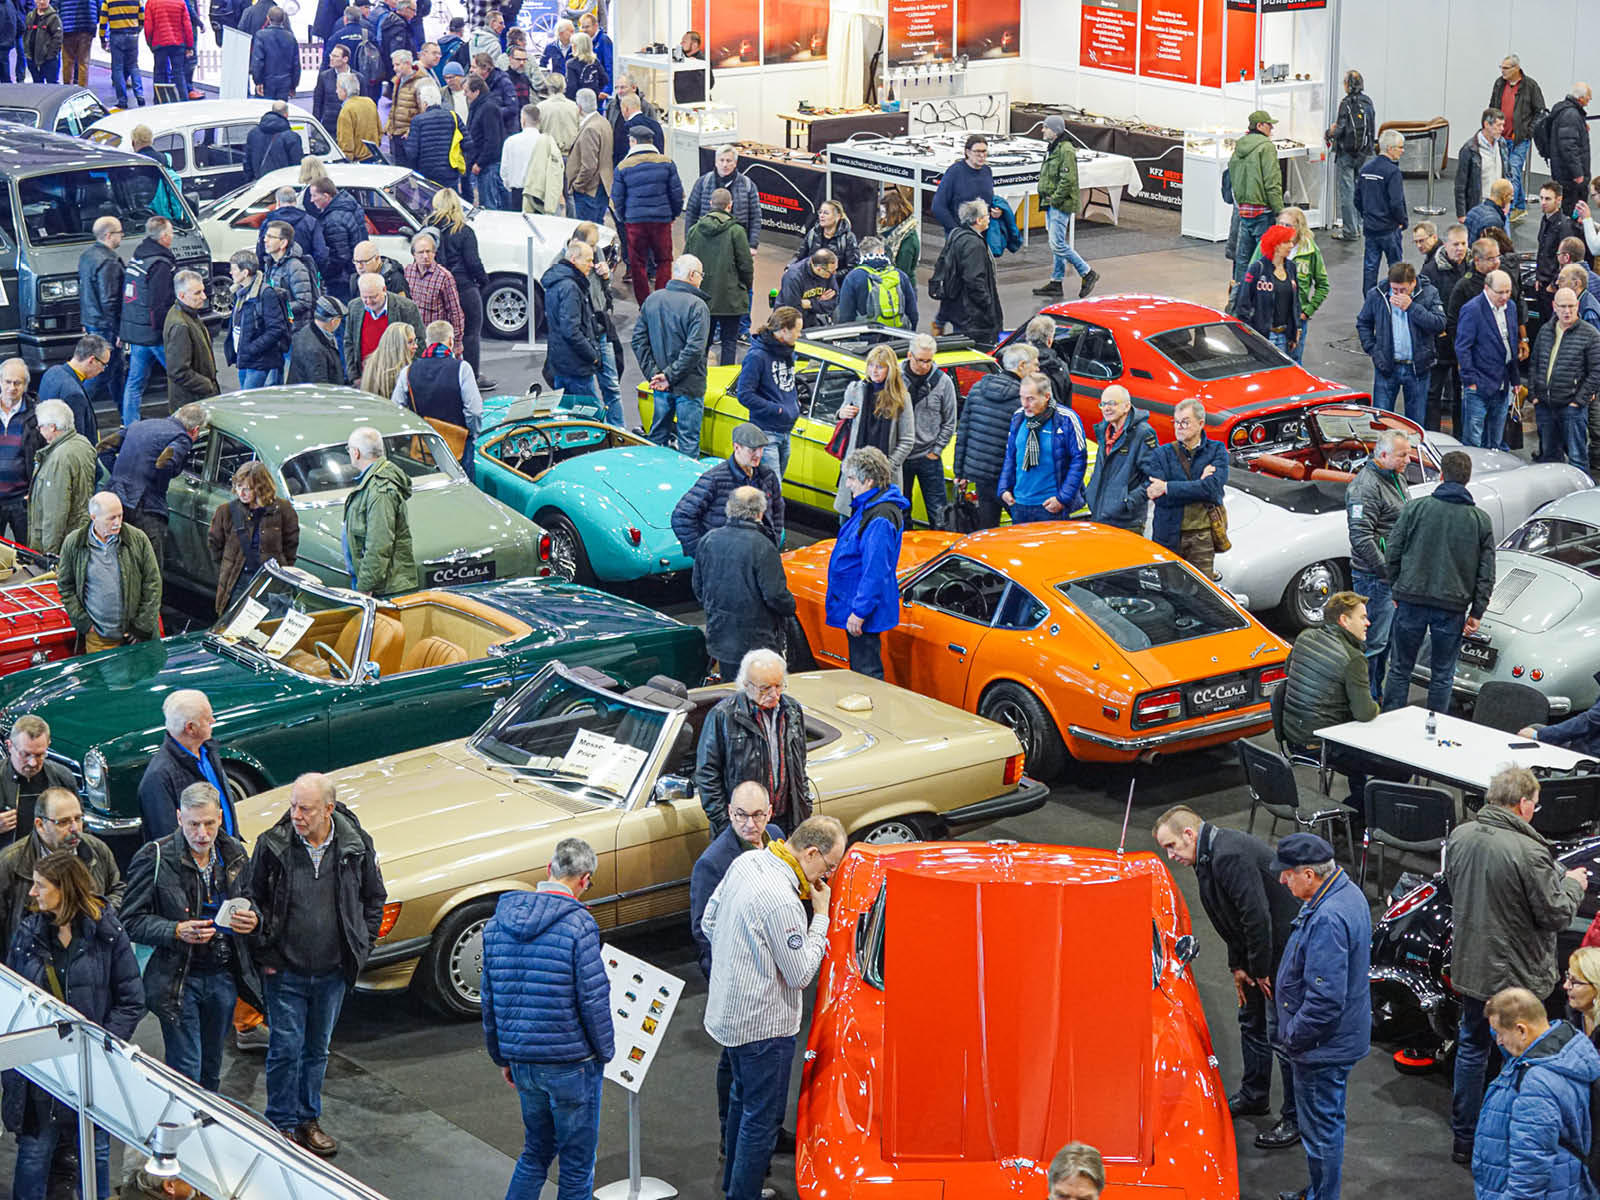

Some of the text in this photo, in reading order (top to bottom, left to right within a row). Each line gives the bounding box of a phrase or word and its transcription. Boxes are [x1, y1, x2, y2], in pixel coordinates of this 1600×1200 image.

[836, 157, 909, 176] www.schwarzbach-classic.de
[1149, 167, 1164, 177] KFZ
[433, 566, 490, 583] CC-Cars
[1193, 684, 1248, 705] CC-Cars
